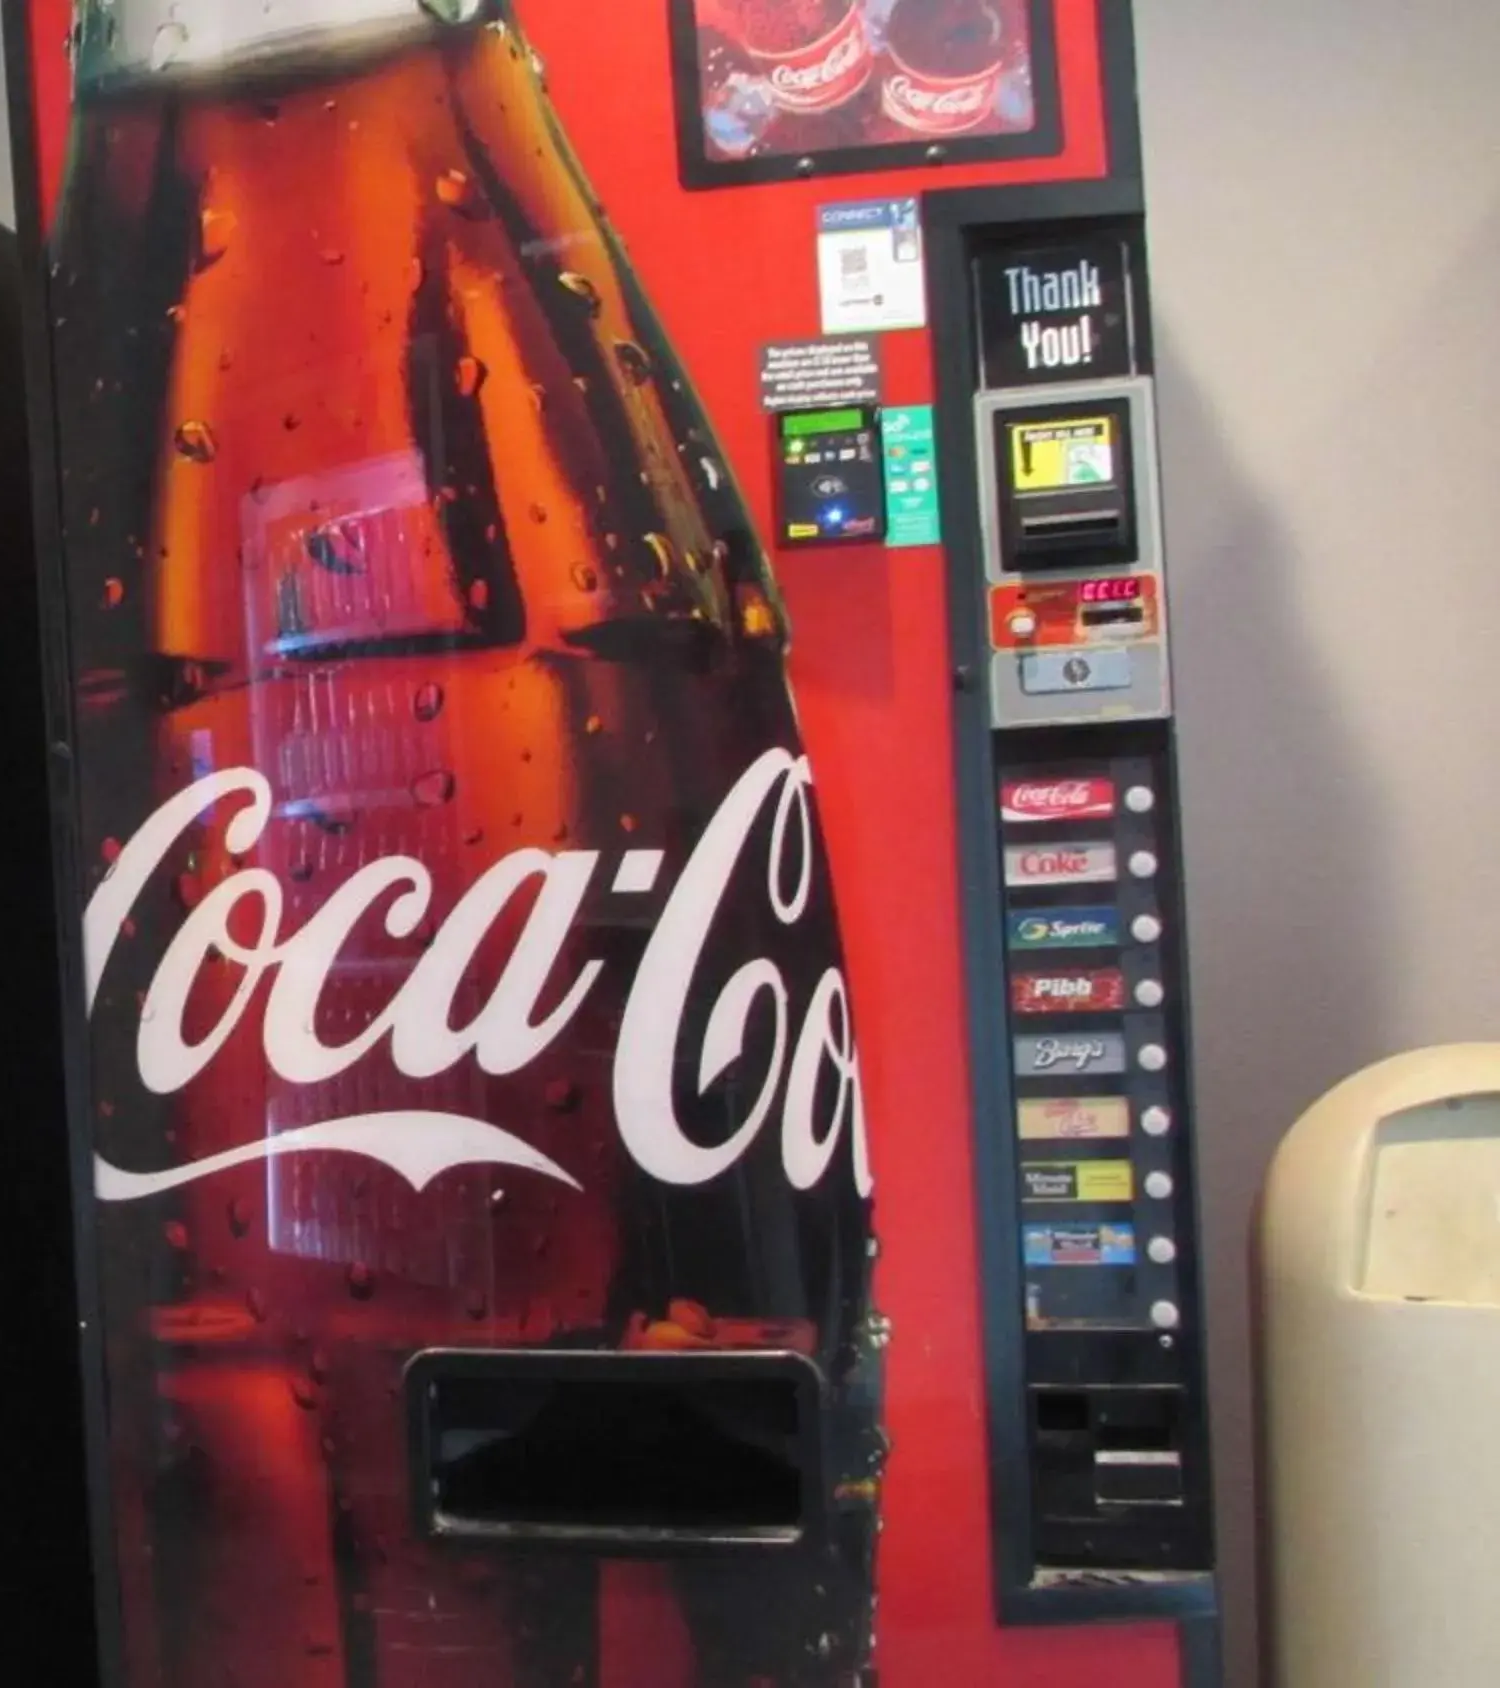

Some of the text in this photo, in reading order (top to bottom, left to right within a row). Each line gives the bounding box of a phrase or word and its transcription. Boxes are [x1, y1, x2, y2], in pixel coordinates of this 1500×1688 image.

[1003, 259, 1102, 315] Thank
[1020, 314, 1093, 369] You!
[1012, 782, 1090, 808] Coca-Cola
[1019, 850, 1089, 876] Coke
[1048, 919, 1106, 939] Sprite
[1033, 977, 1094, 998] Pibb
